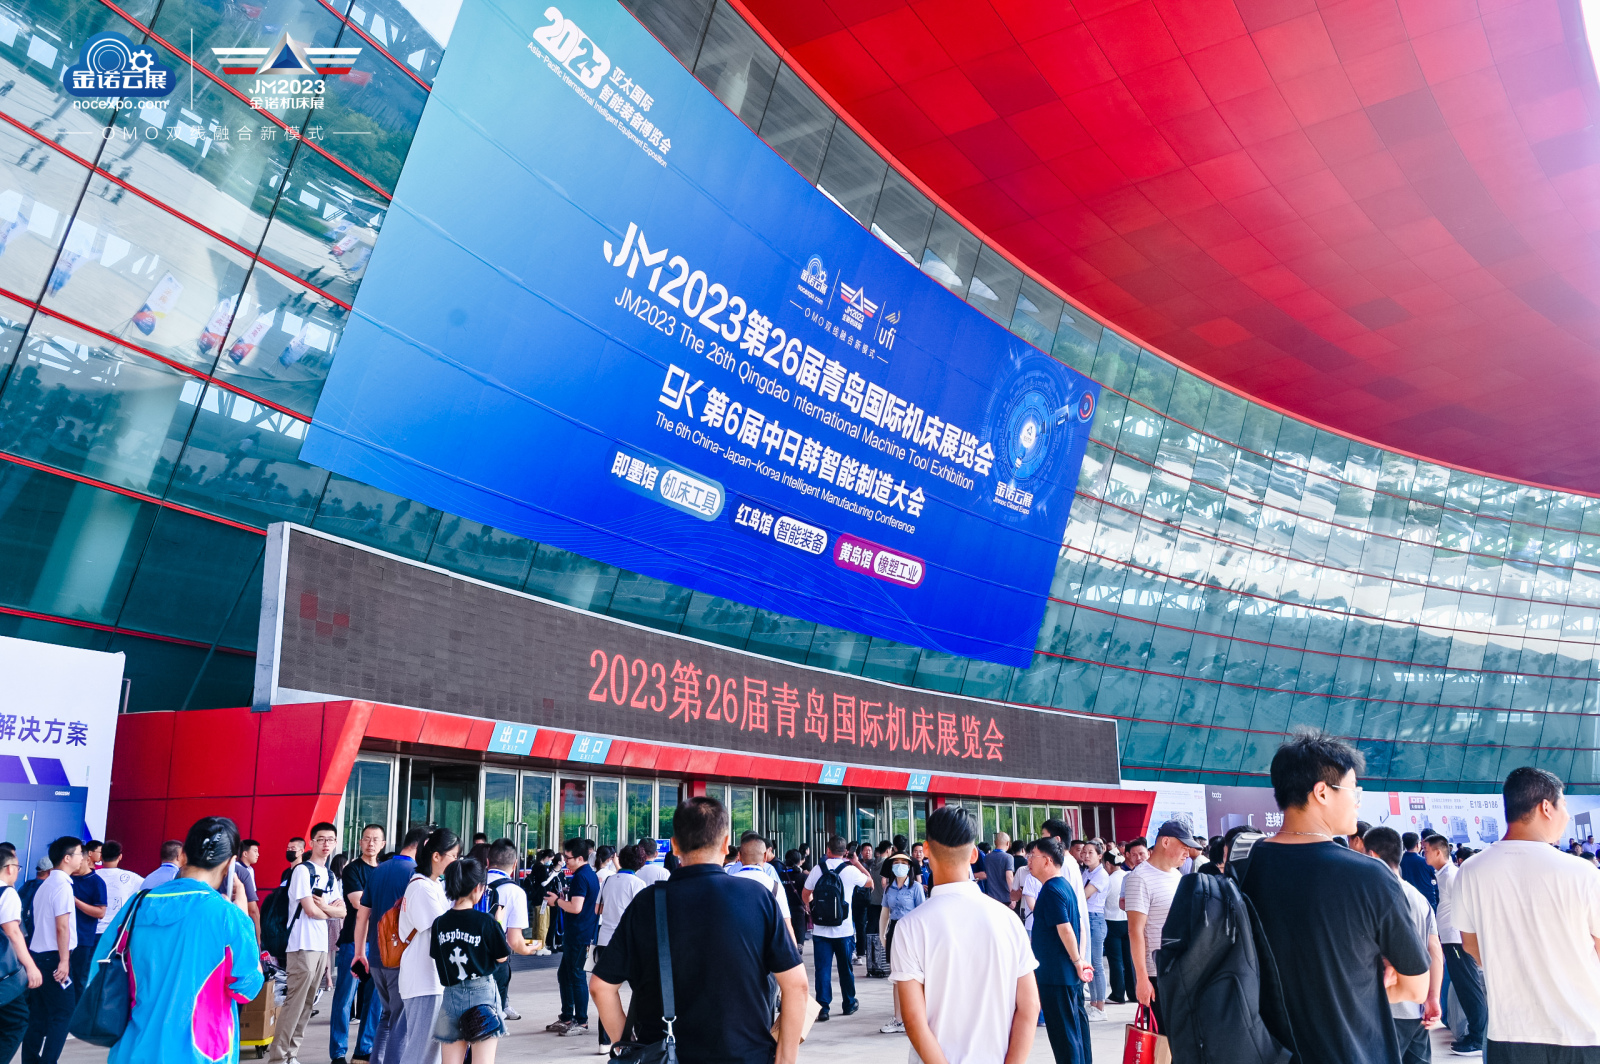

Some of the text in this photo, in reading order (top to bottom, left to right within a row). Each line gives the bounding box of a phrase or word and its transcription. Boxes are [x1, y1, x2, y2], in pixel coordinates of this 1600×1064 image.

[533, 6, 611, 89] 2023
[527, 41, 562, 78] Asia-Pacific
[562, 72, 595, 106] International
[593, 101, 619, 127] Intelligent
[617, 121, 644, 148] Equipment
[609, 66, 654, 112] 亚太国际
[598, 83, 672, 155] 智能装备博览会
[603, 221, 995, 477] JM2023第26届青岛国际机床展览会
[878, 327, 897, 351] ufi
[614, 286, 676, 336] JM2023
[680, 322, 704, 354] The
[706, 341, 736, 373] 26th
[738, 360, 790, 403] Qingdao
[861, 425, 906, 460] Machine
[908, 448, 930, 471] Tool
[929, 459, 974, 491] Exhibition
[656, 410, 674, 432] The
[675, 422, 691, 441] 6th
[781, 471, 820, 499] Intelligent
[820, 488, 874, 521] Manufacturing
[874, 509, 916, 534] Conference
[700, 386, 925, 518] 第6届中日韩智能制造大会
[611, 450, 717, 515] 即墨馆 机床工具
[995, 481, 1034, 508] 金诺云展
[734, 502, 824, 554] 红岛馆 智能装备
[838, 541, 918, 583] 黄岛馆 橡塑工业
[588, 649, 1005, 762] 2023第26届青岛国际机床展览会
[499, 725, 528, 744] 出口
[502, 744, 518, 752] EXIT
[578, 737, 604, 754] 出口
[825, 766, 841, 777] 入口
[912, 775, 926, 786] 入口
